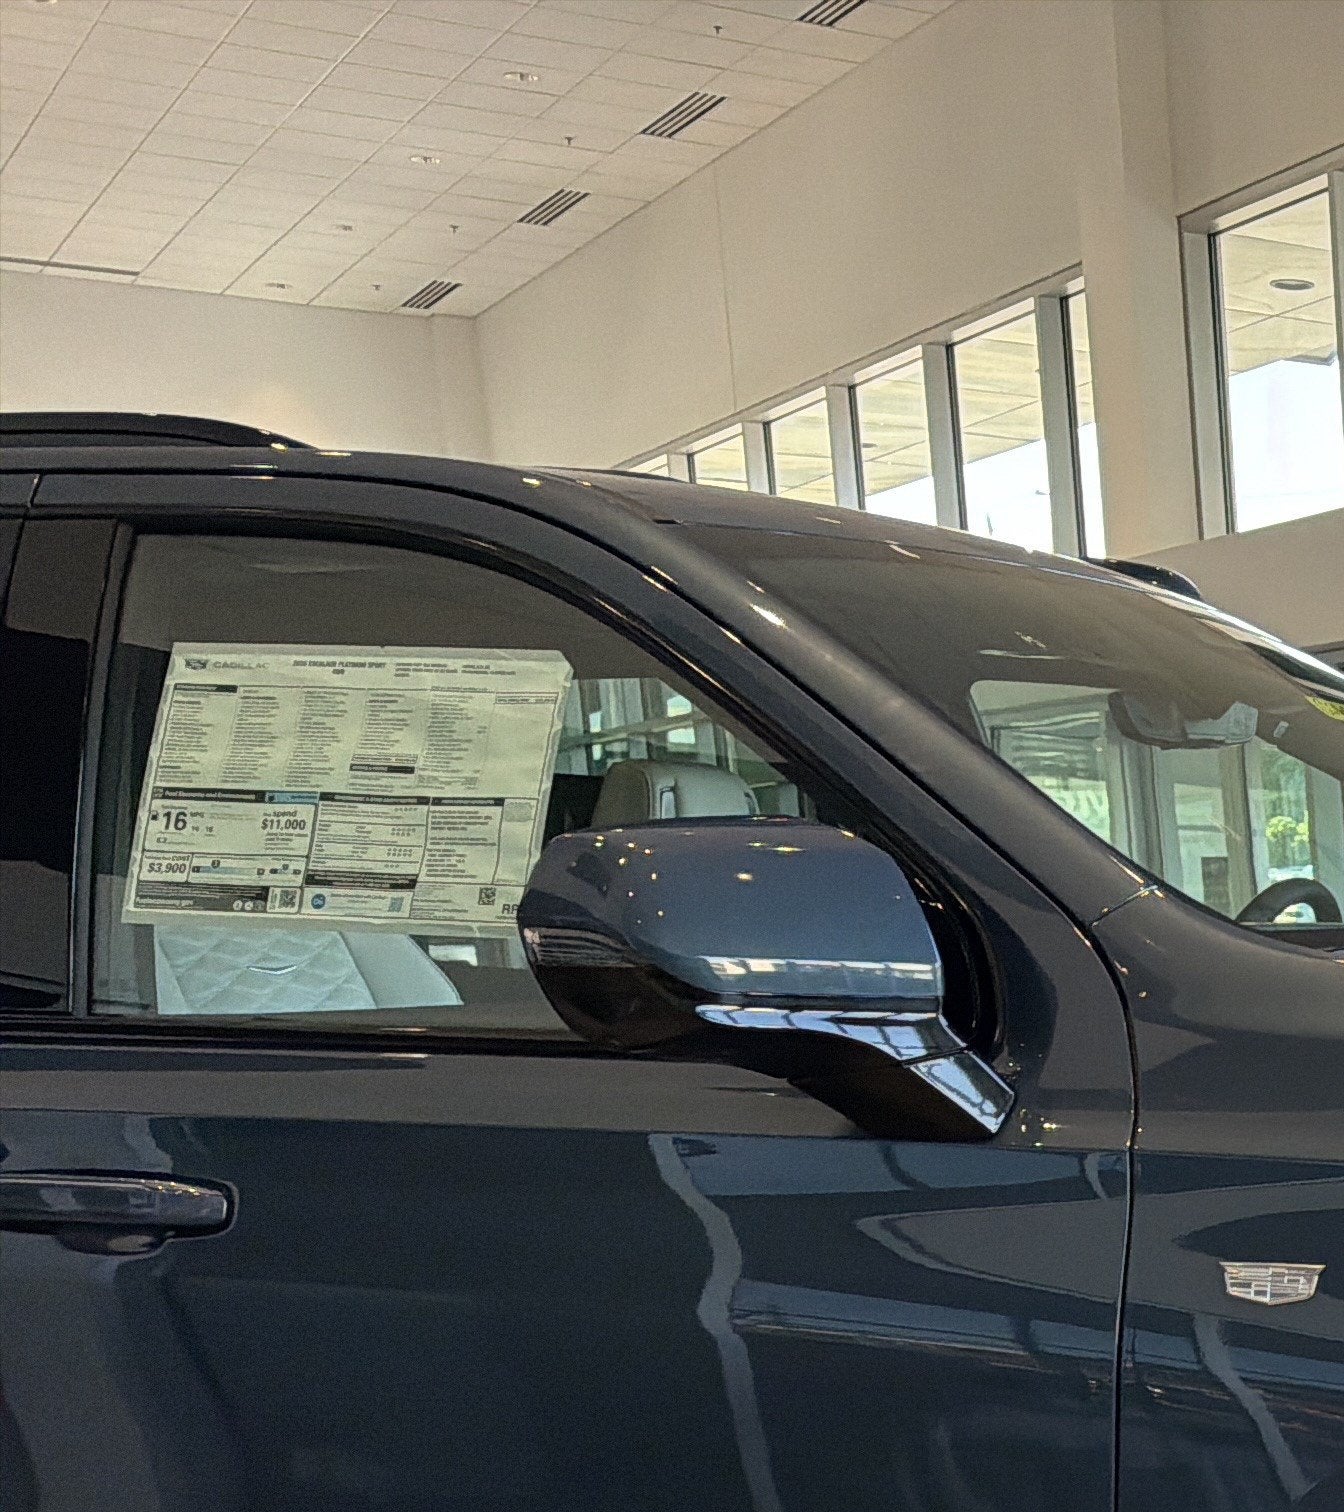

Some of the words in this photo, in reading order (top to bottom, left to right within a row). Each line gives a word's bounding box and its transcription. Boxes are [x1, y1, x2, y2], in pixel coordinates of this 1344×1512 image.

[162, 811, 188, 831] 16
[261, 818, 307, 831] $11,000
[148, 862, 187, 873] $3,900
